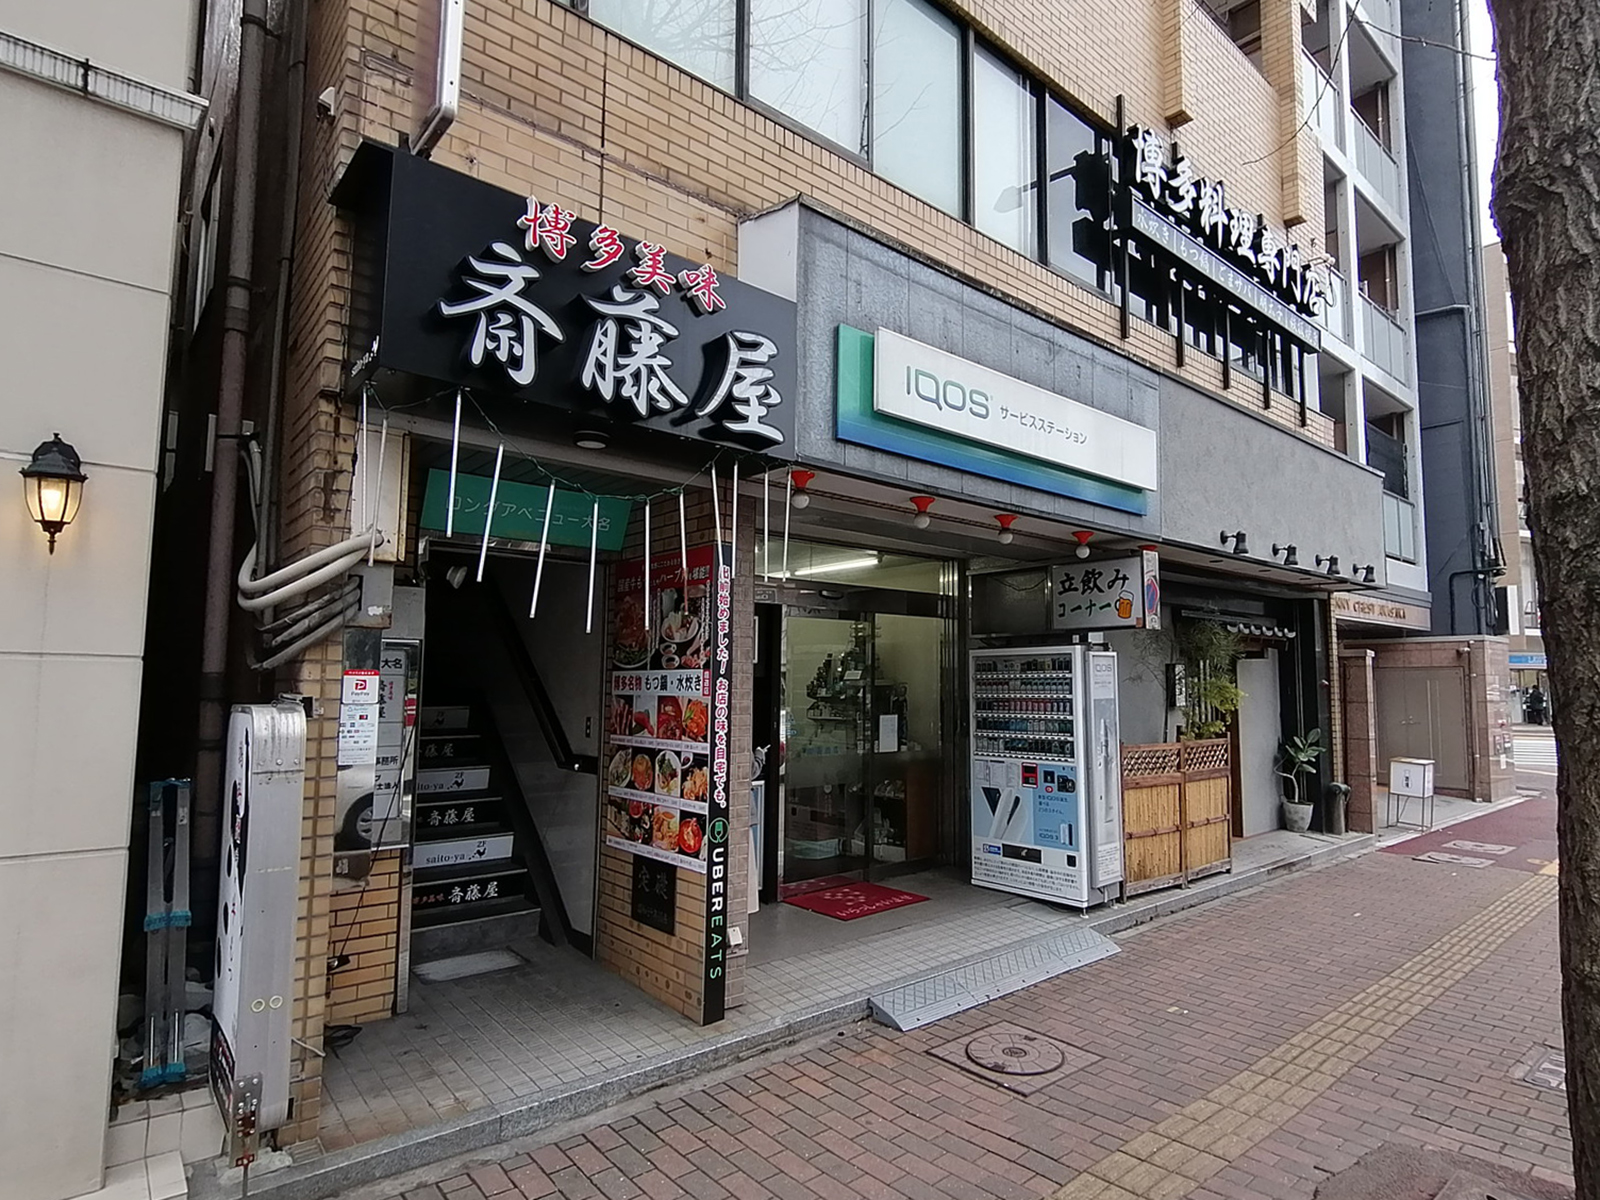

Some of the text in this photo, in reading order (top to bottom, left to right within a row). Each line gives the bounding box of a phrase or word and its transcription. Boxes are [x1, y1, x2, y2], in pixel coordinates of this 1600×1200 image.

[1137, 210, 1171, 245] 水炊き
[513, 195, 727, 314] 博多美味
[440, 243, 785, 442] 斎藤屋
[906, 365, 990, 419] IQOS
[1000, 405, 1088, 445] サービスステーション
[446, 496, 611, 532] ロングアベニュー大名
[1058, 568, 1130, 596] 立飲み
[1058, 599, 1112, 617] コーナー
[381, 657, 403, 670] 大名
[613, 674, 642, 691] 博多名物
[713, 677, 730, 808] お店の味を自宅でも。
[426, 851, 465, 864] saito-ya
[448, 881, 499, 904] 斎藤屋
[709, 847, 725, 980] UBER EATS
